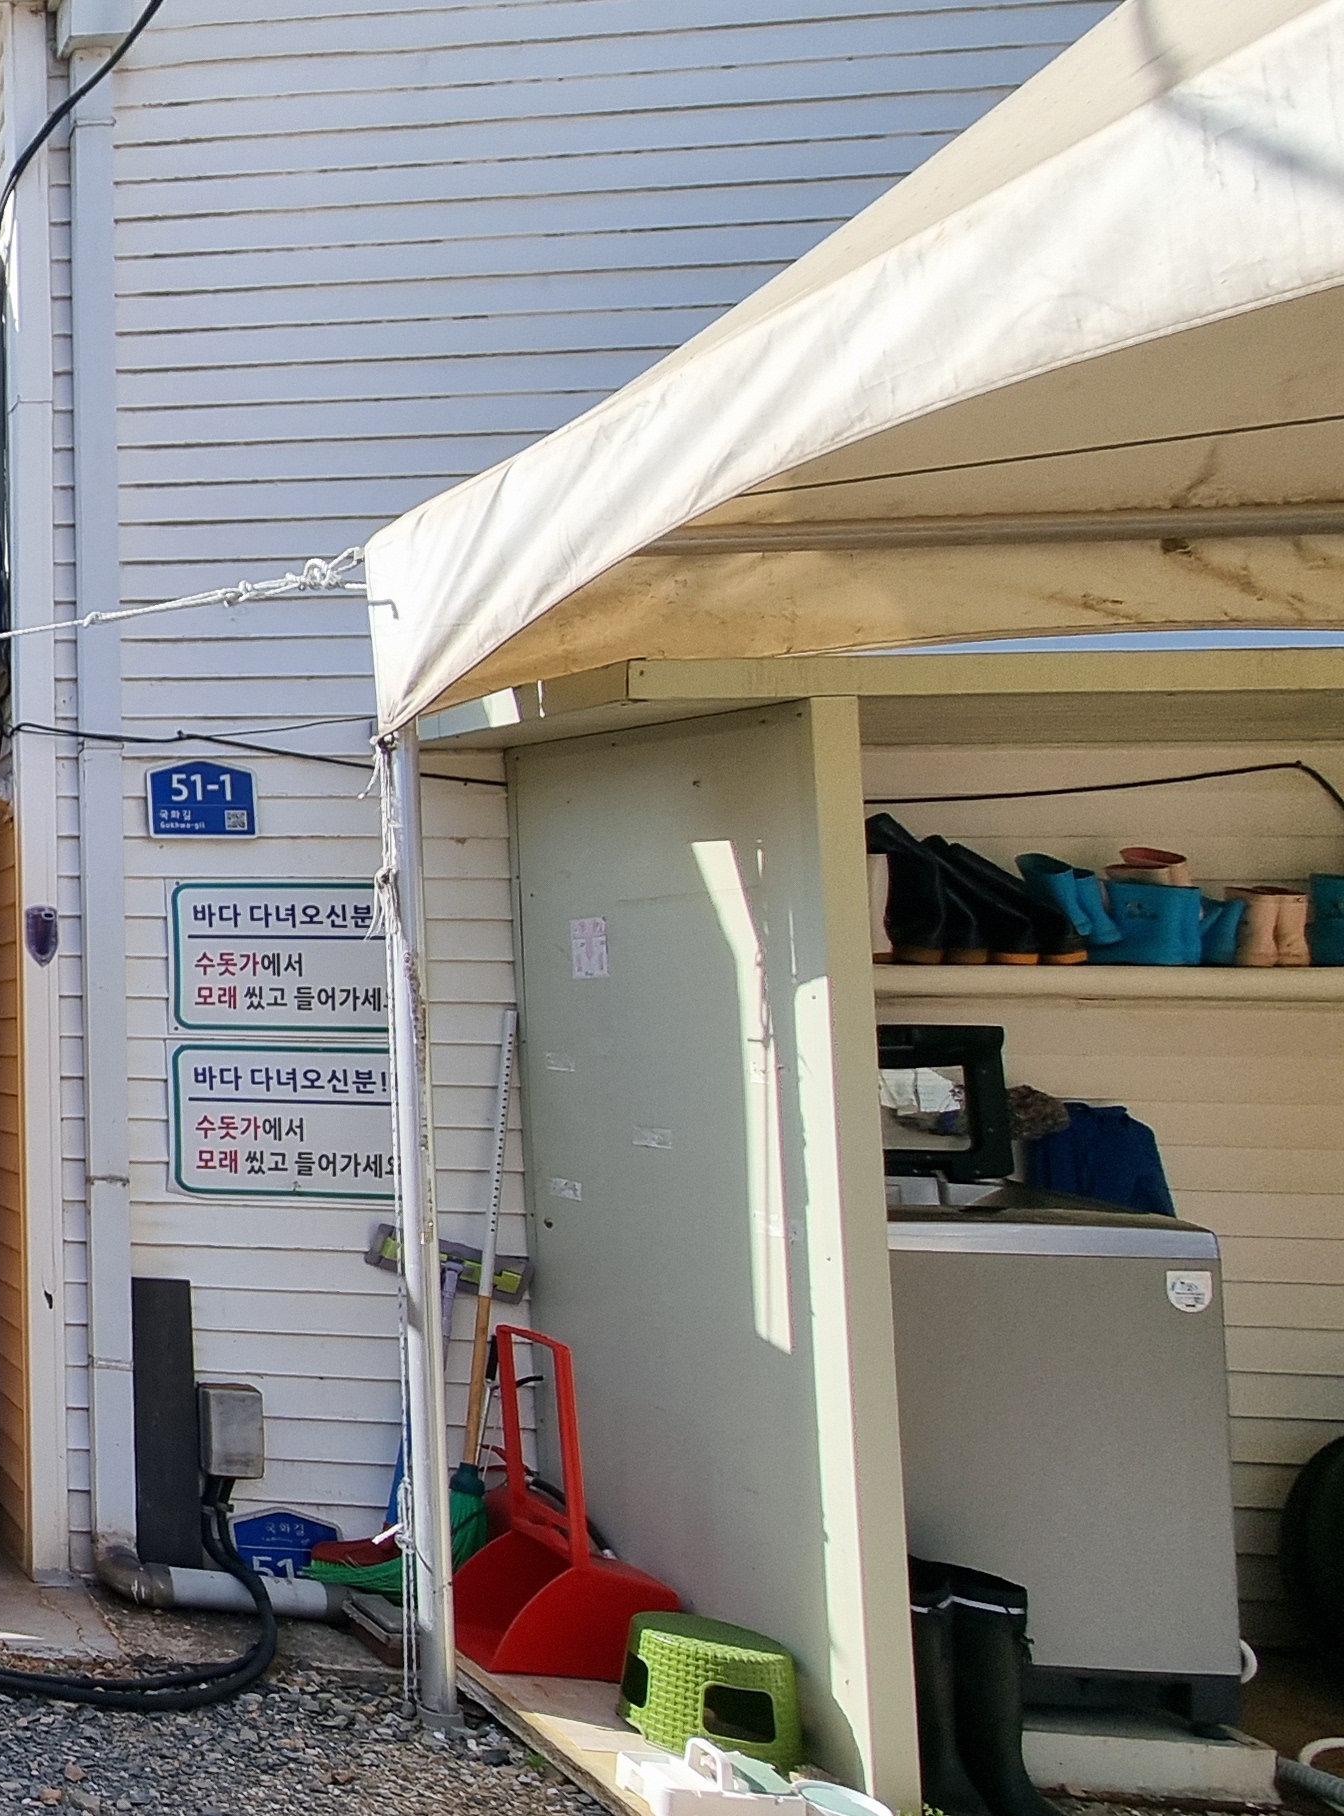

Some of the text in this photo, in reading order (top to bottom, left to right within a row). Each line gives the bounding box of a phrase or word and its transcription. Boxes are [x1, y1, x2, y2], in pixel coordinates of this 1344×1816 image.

[171, 773, 232, 801] 51-1
[192, 903, 242, 929] 바다
[194, 951, 304, 977] 수돗가에서
[194, 985, 238, 1010] 모래
[293, 985, 389, 1013] 들어가세
[193, 1065, 243, 1092] 바다
[194, 1114, 305, 1143] 수돗가에서
[195, 1149, 239, 1175] 모래
[252, 1555, 295, 1579] 51
